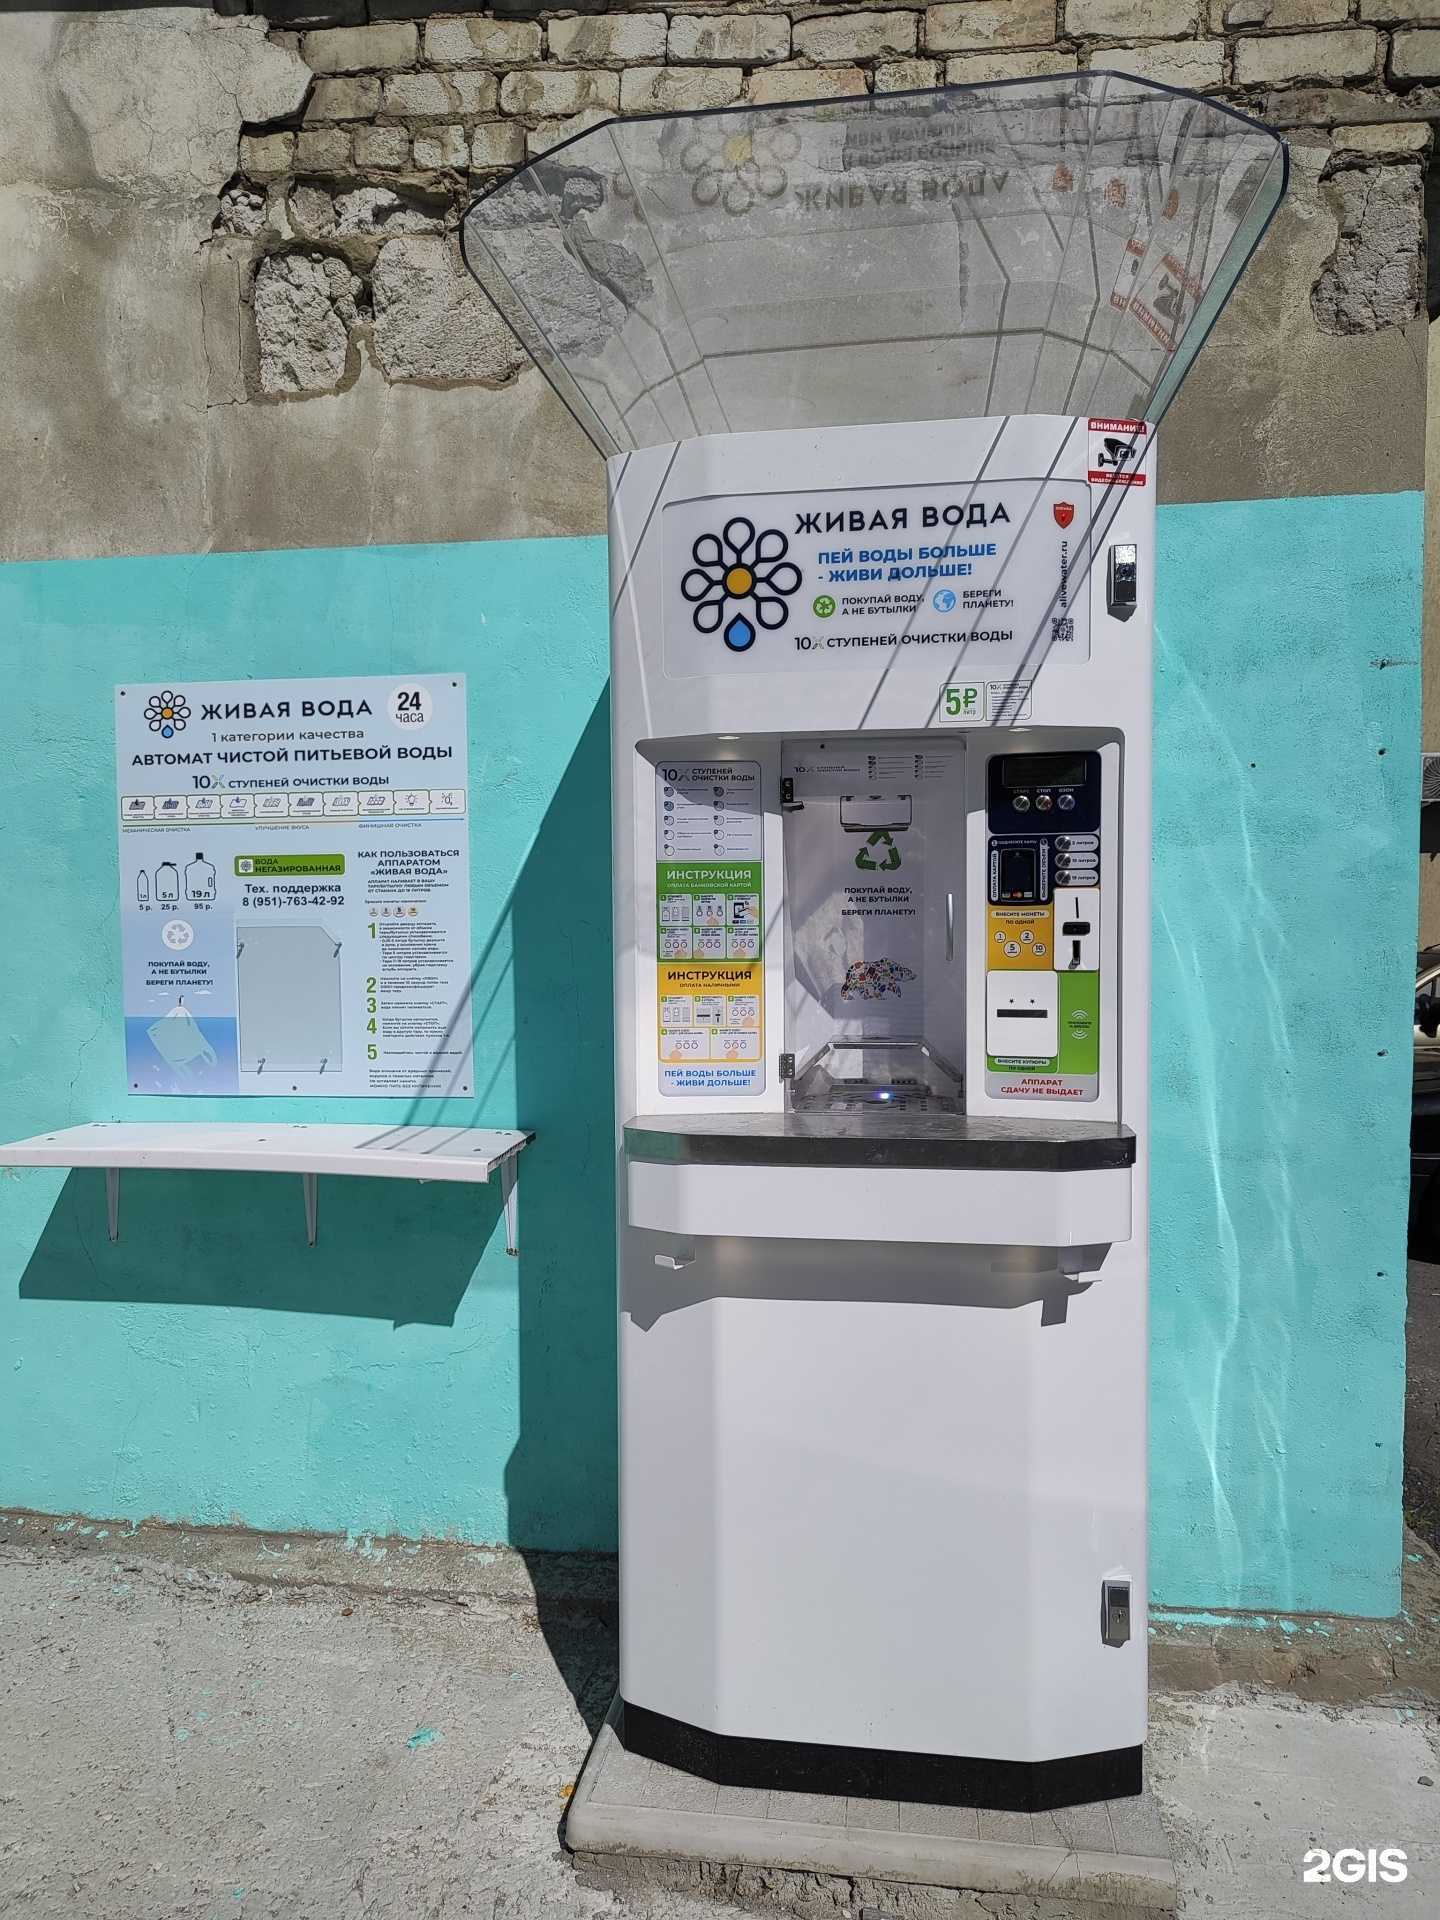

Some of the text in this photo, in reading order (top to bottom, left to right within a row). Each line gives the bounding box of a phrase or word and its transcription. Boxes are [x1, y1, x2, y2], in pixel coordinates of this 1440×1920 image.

[795, 502, 1010, 534] ЖИВАЯ ВОДА
[818, 543, 996, 564] ПЕЙ ВОДЫ БОЛЬШЕ
[829, 568, 882, 582] ЖИВИ
[887, 563, 972, 582] ДОЛЬШЕ!
[1059, 541, 1068, 607] alivewater.ru
[963, 589, 1001, 598] БЕРЕГИ
[842, 594, 925, 605] ПОКУПАЙ ВОДУ,
[963, 600, 1013, 609] ПЛАНЕТУ!
[868, 605, 916, 615] БУТЫЛКИ
[827, 634, 897, 648] СТУПЕНЕЙ
[901, 632, 966, 645] ОЧИСТКИ
[970, 630, 1013, 643] ВОДЫ
[397, 692, 422, 711] 24
[201, 700, 372, 720] ЖИВАЯ ВОДА
[395, 712, 424, 723] часа
[211, 730, 364, 743] 1 категории качества
[132, 745, 452, 766] АВТОМАТ ЧИСТОЙ ПИТЬЕВОЙ ВОДЫ
[228, 778, 289, 788] СТУПЕНЕЙ
[293, 777, 349, 786] ОЧИСТКИ
[353, 776, 389, 785] ВОДЫ
[380, 850, 460, 858] ПОЛЬЗОВАТЬСЯ
[255, 864, 341, 873] НЕГАЗИРОВАННАЯ
[378, 859, 440, 867] АППАРАТОМ
[667, 870, 751, 880] ИНСТРУКЦИЯ
[245, 884, 341, 894] Тех. поддержка
[243, 896, 344, 907] 8 (951)-763-42-92
[368, 922, 376, 939] 1
[1009, 943, 1016, 951] 5
[668, 971, 752, 981] ИНСТРУКЦИЯ
[366, 977, 377, 993] 2
[367, 997, 377, 1013] 3
[366, 1018, 377, 1034] 4
[367, 1044, 377, 1060] 5
[665, 1069, 683, 1077] ПЕЙ
[686, 1070, 714, 1078] ВОДЫ
[1001, 1086, 1030, 1094] СДАЧУ
[1046, 1088, 1084, 1096] ВЫДАЕТ
